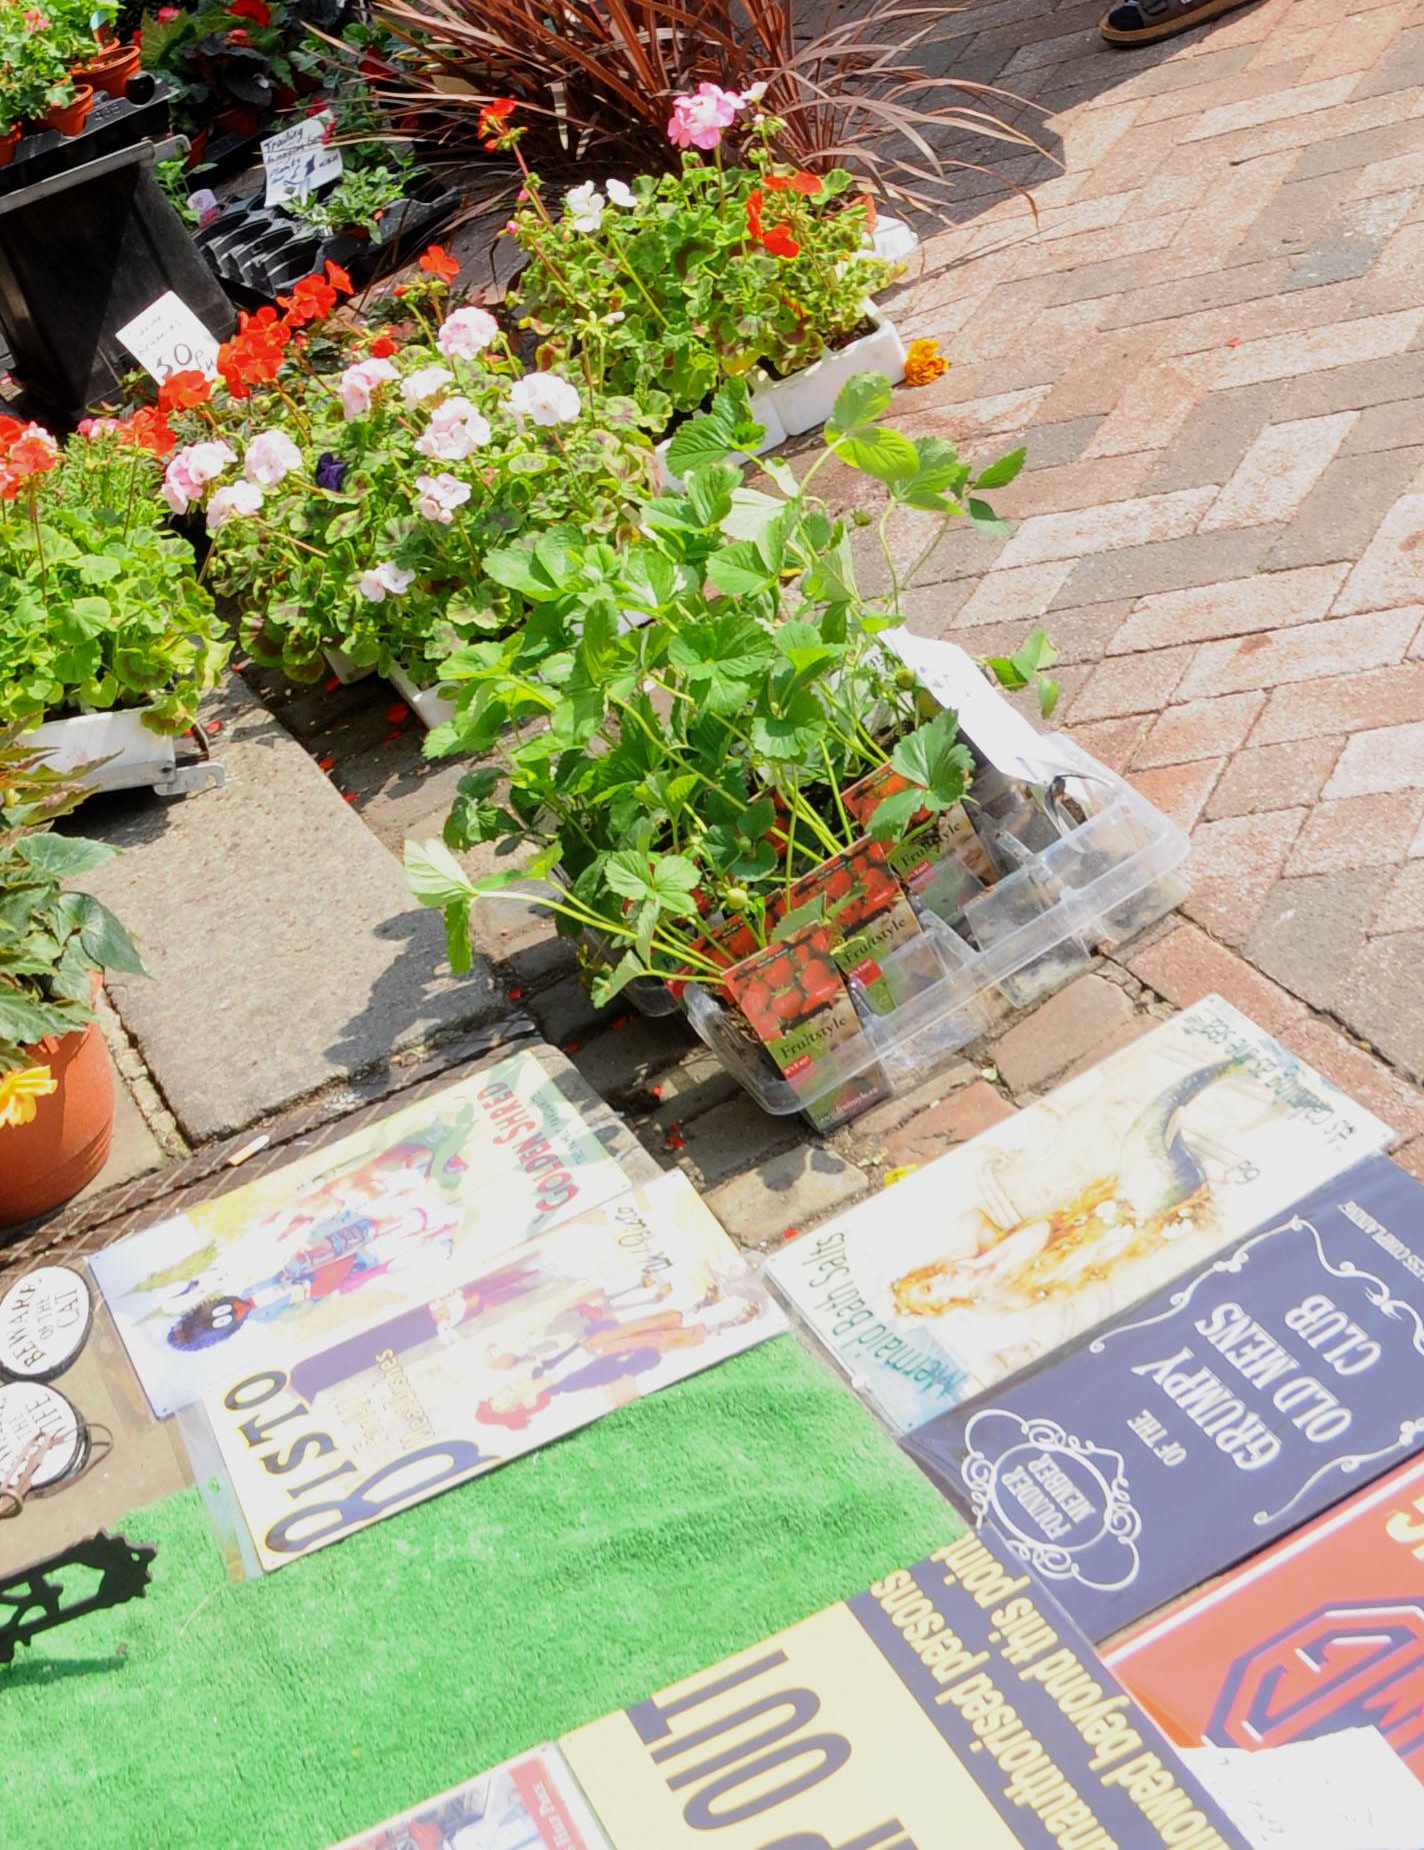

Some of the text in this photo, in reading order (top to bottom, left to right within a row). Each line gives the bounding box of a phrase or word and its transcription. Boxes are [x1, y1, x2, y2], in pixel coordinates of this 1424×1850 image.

[843, 916, 907, 965] Fruitstyle
[780, 1014, 847, 1059] Fruitstyle
[476, 1082, 580, 1211] GOLDEN SHRED
[8, 1285, 48, 1368] BEWARE
[36, 1294, 53, 1325] THE
[54, 1288, 81, 1330] CAT
[802, 1232, 969, 1399] Mermaid Bath Salts
[1283, 1293, 1383, 1377] CLUB
[1130, 1345, 1282, 1472] GRUMPY
[1193, 1301, 1354, 1444] OLD MENS
[224, 1370, 502, 1554] BISTO
[1127, 1409, 1187, 1467] OF THE
[1000, 1465, 1073, 1542] FOUNDER
[1027, 1452, 1097, 1527] MEMBER
[928, 1530, 1032, 1610] point
[870, 1568, 991, 1685] persons
[987, 1596, 1059, 1666] this
[624, 1648, 853, 1831] OUT
[1016, 1647, 1146, 1772] beyond
